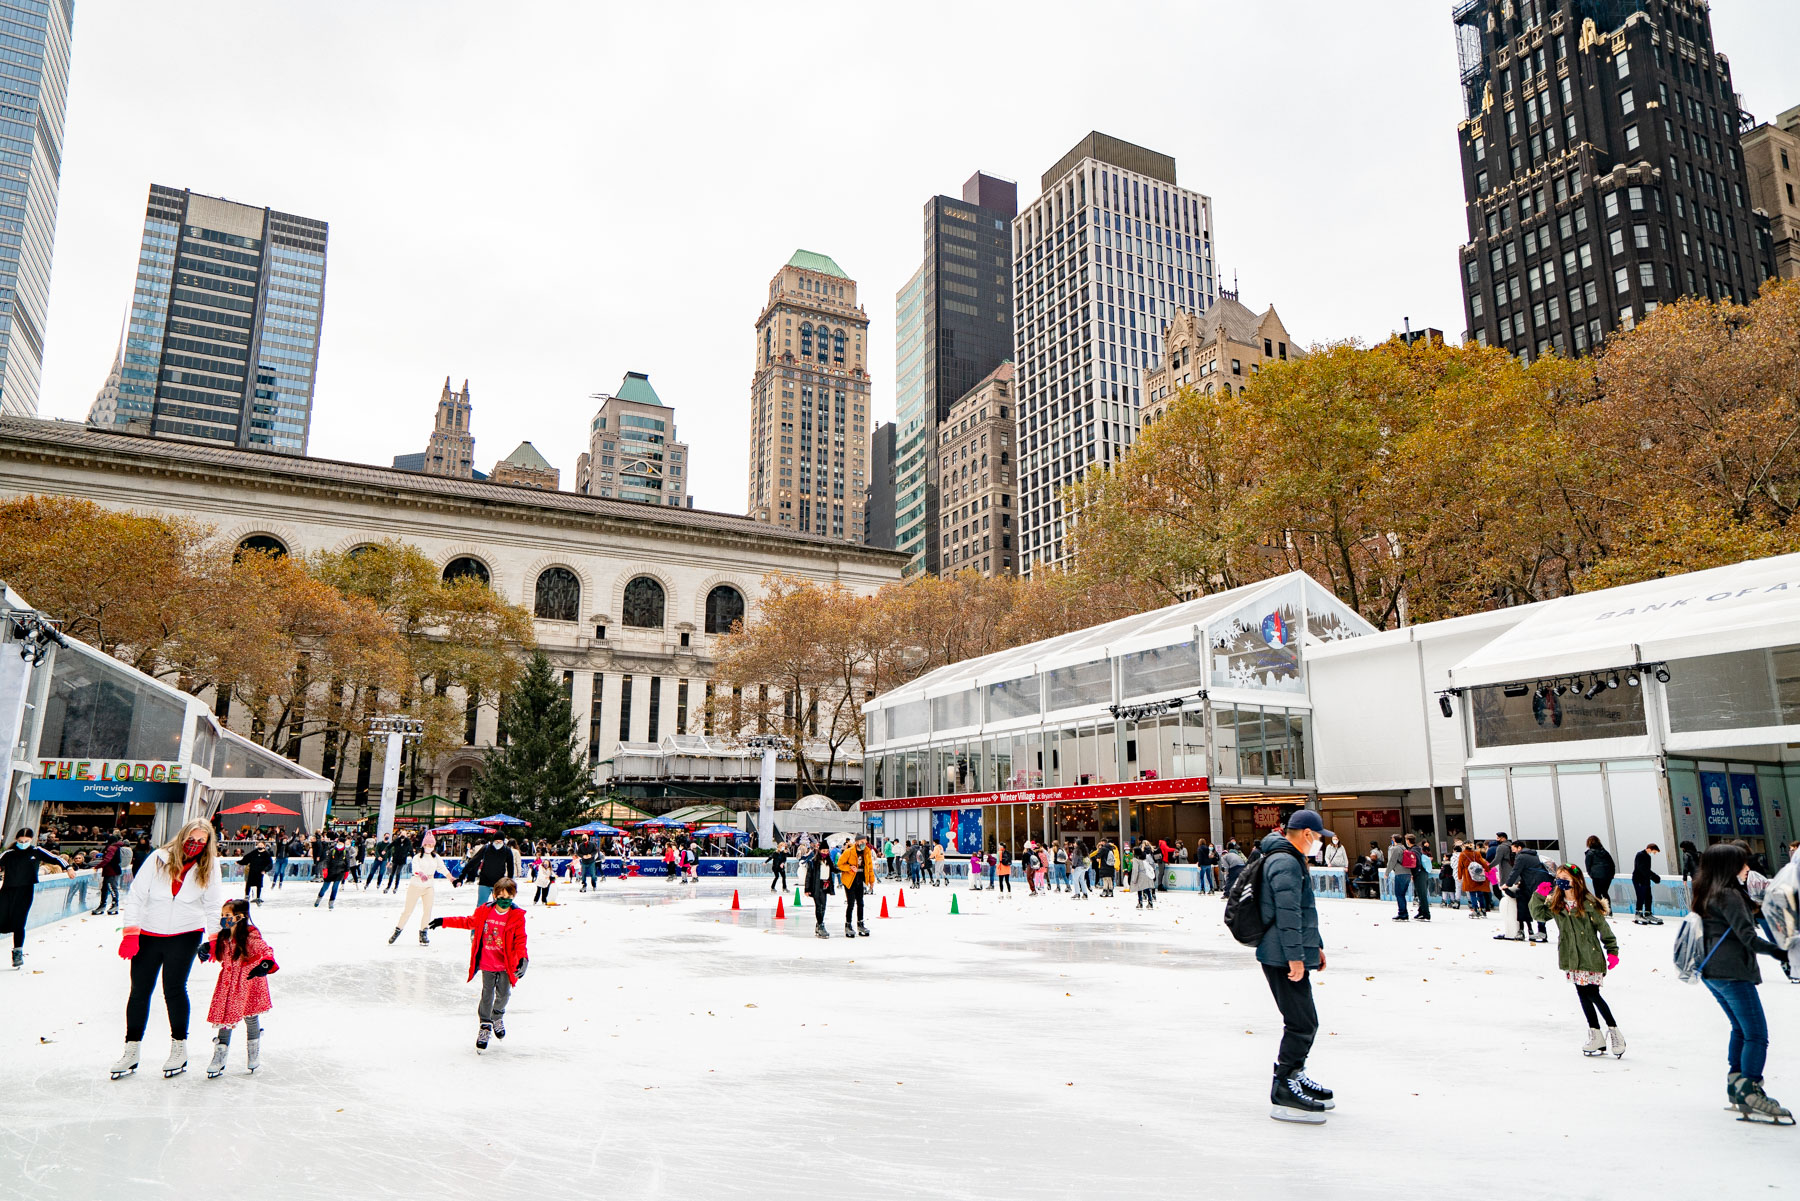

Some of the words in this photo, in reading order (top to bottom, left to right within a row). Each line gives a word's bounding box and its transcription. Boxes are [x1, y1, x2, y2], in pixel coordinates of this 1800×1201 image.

[1595, 596, 1694, 621] BANK
[1705, 587, 1758, 601] OF
[1763, 582, 1800, 593] A
[40, 761, 91, 780] THE
[101, 762, 182, 783] LODGE
[83, 784, 109, 792] prime
[1000, 793, 1017, 802] Winter
[1017, 792, 1035, 802] Village
[1041, 793, 1053, 801] Bryant
[1711, 807, 1725, 816] BAG
[1741, 808, 1755, 817] BAG
[1258, 813, 1275, 822] EXIT
[1708, 816, 1730, 824] CHECK
[1739, 817, 1760, 825] CHECK
[643, 866, 658, 874] every
